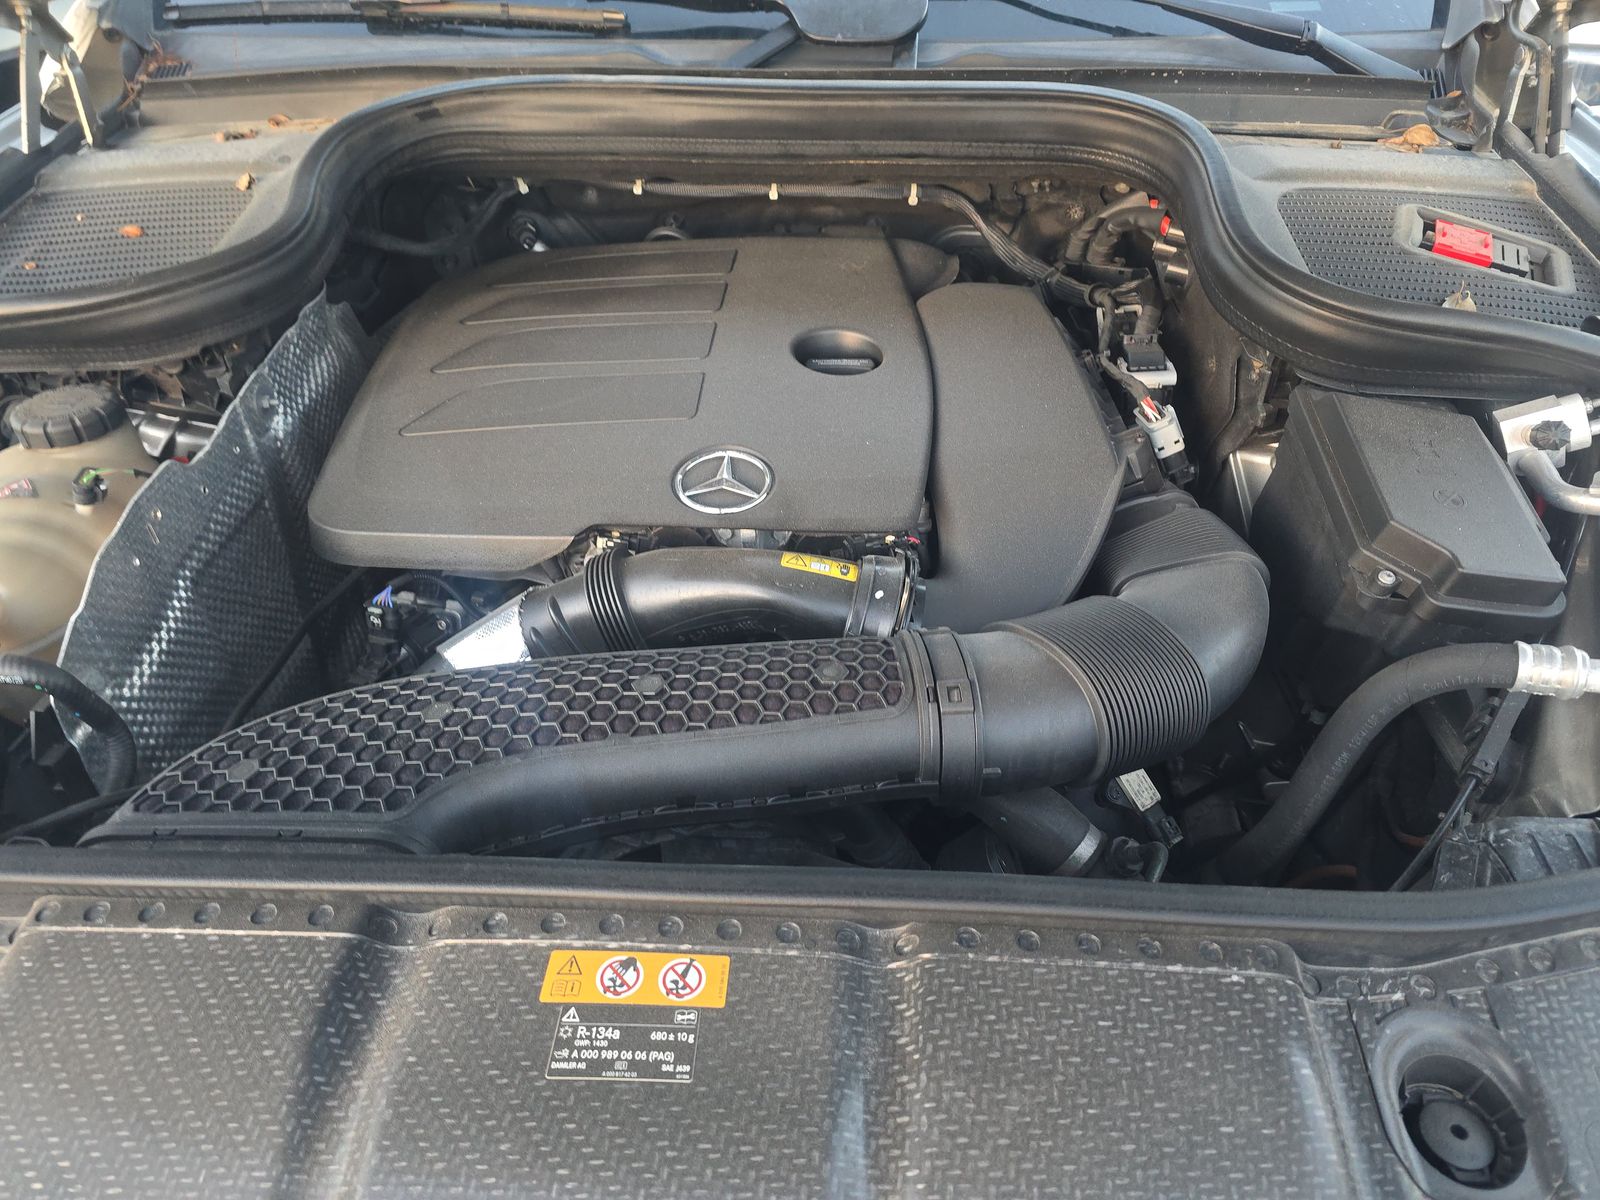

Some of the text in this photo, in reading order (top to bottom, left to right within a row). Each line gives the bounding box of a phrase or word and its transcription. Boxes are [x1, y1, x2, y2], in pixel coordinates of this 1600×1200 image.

[577, 1026, 620, 1039] R-134a
[651, 1031, 667, 1040] 680
[571, 1050, 674, 1062] A 000 989 06 06 (PAG)
[662, 1064, 674, 1072] SAE
